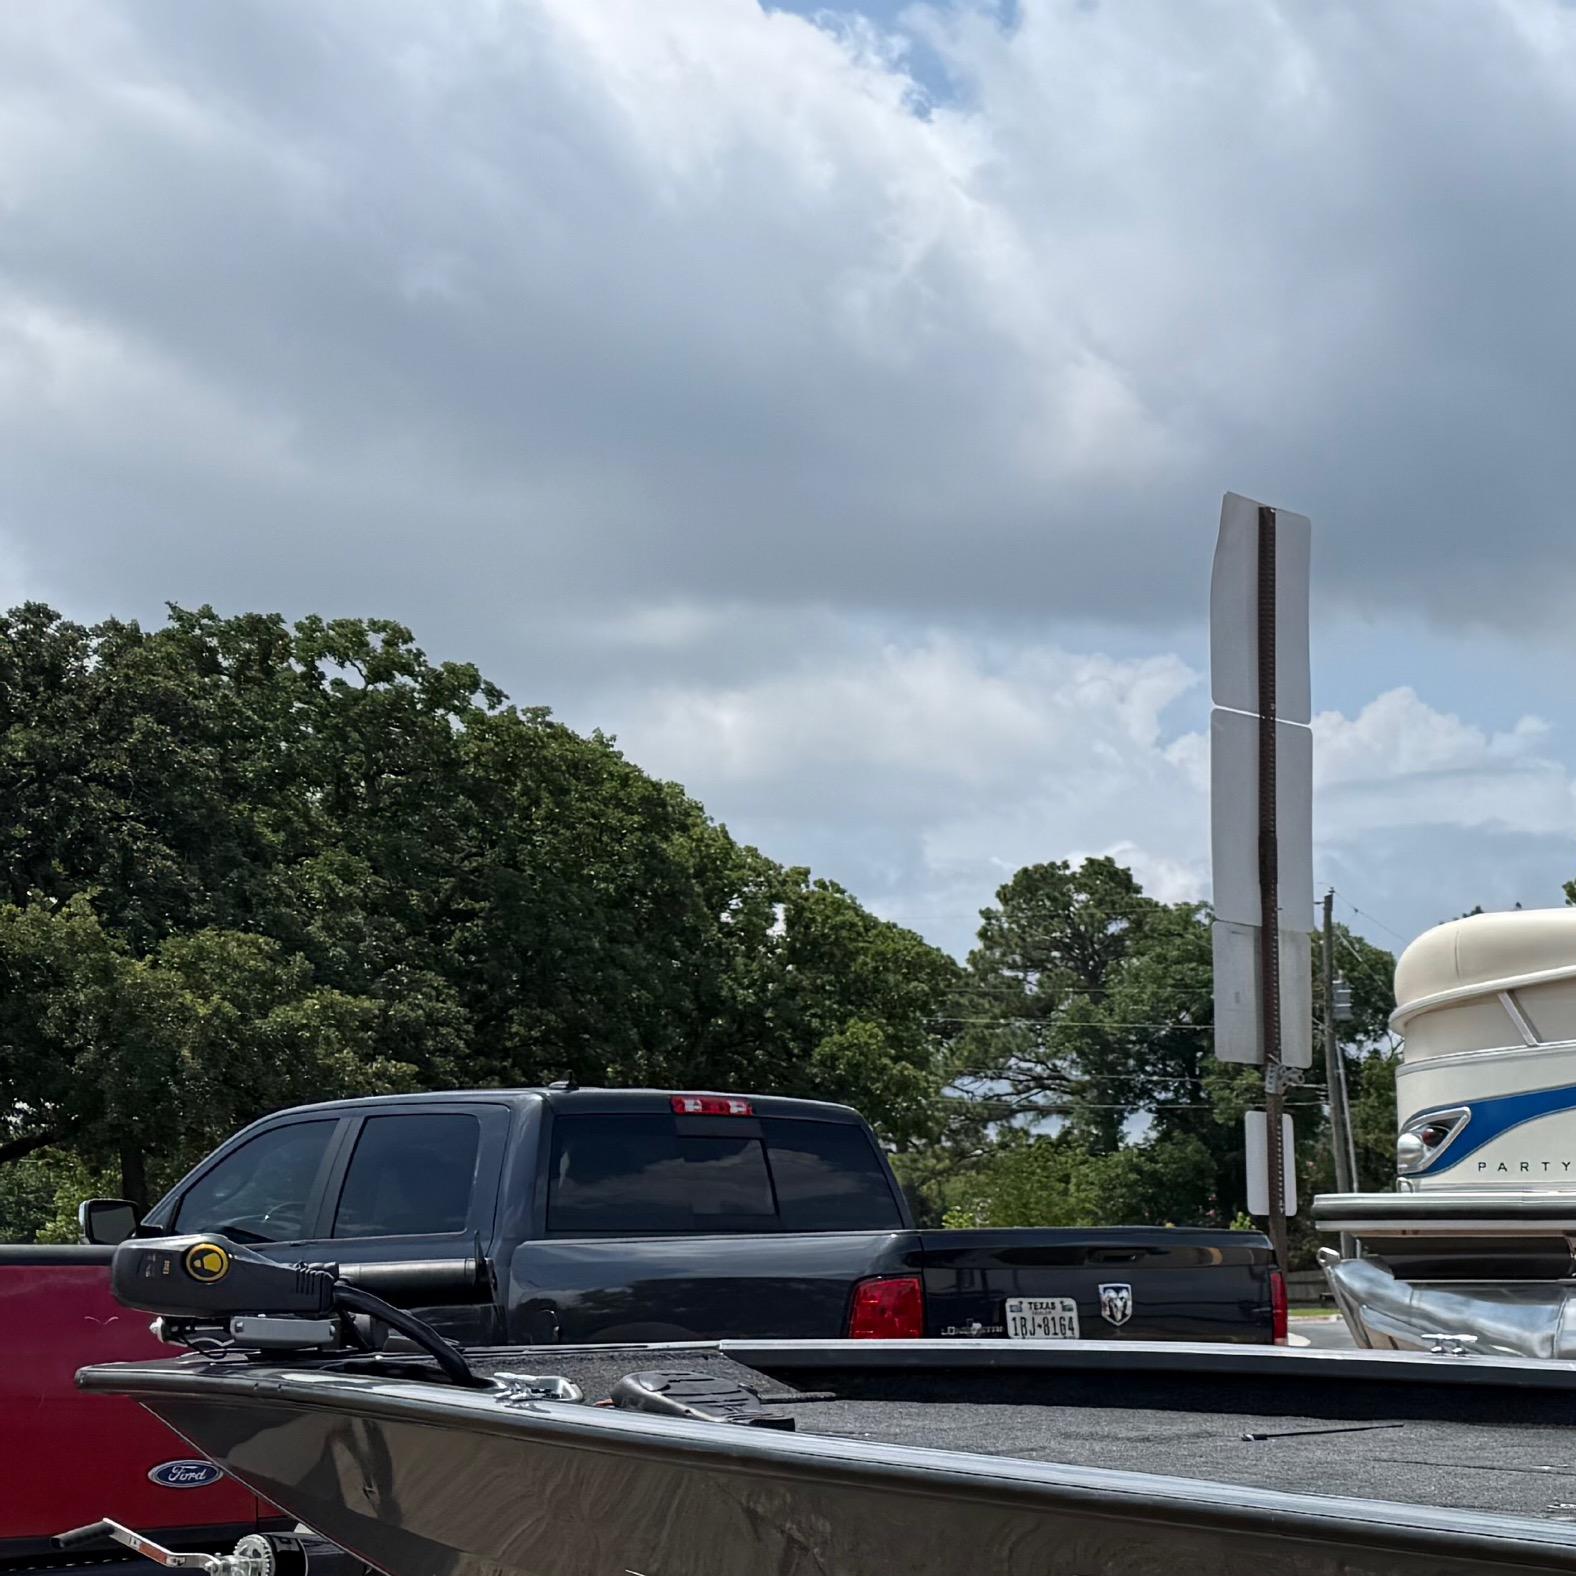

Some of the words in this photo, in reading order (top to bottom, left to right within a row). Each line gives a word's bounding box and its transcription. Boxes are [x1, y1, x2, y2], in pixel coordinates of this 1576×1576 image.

[1477, 1160, 1572, 1173] PARTY
[1027, 1301, 1056, 1311] TEXAS
[167, 1465, 208, 1482] Ford
